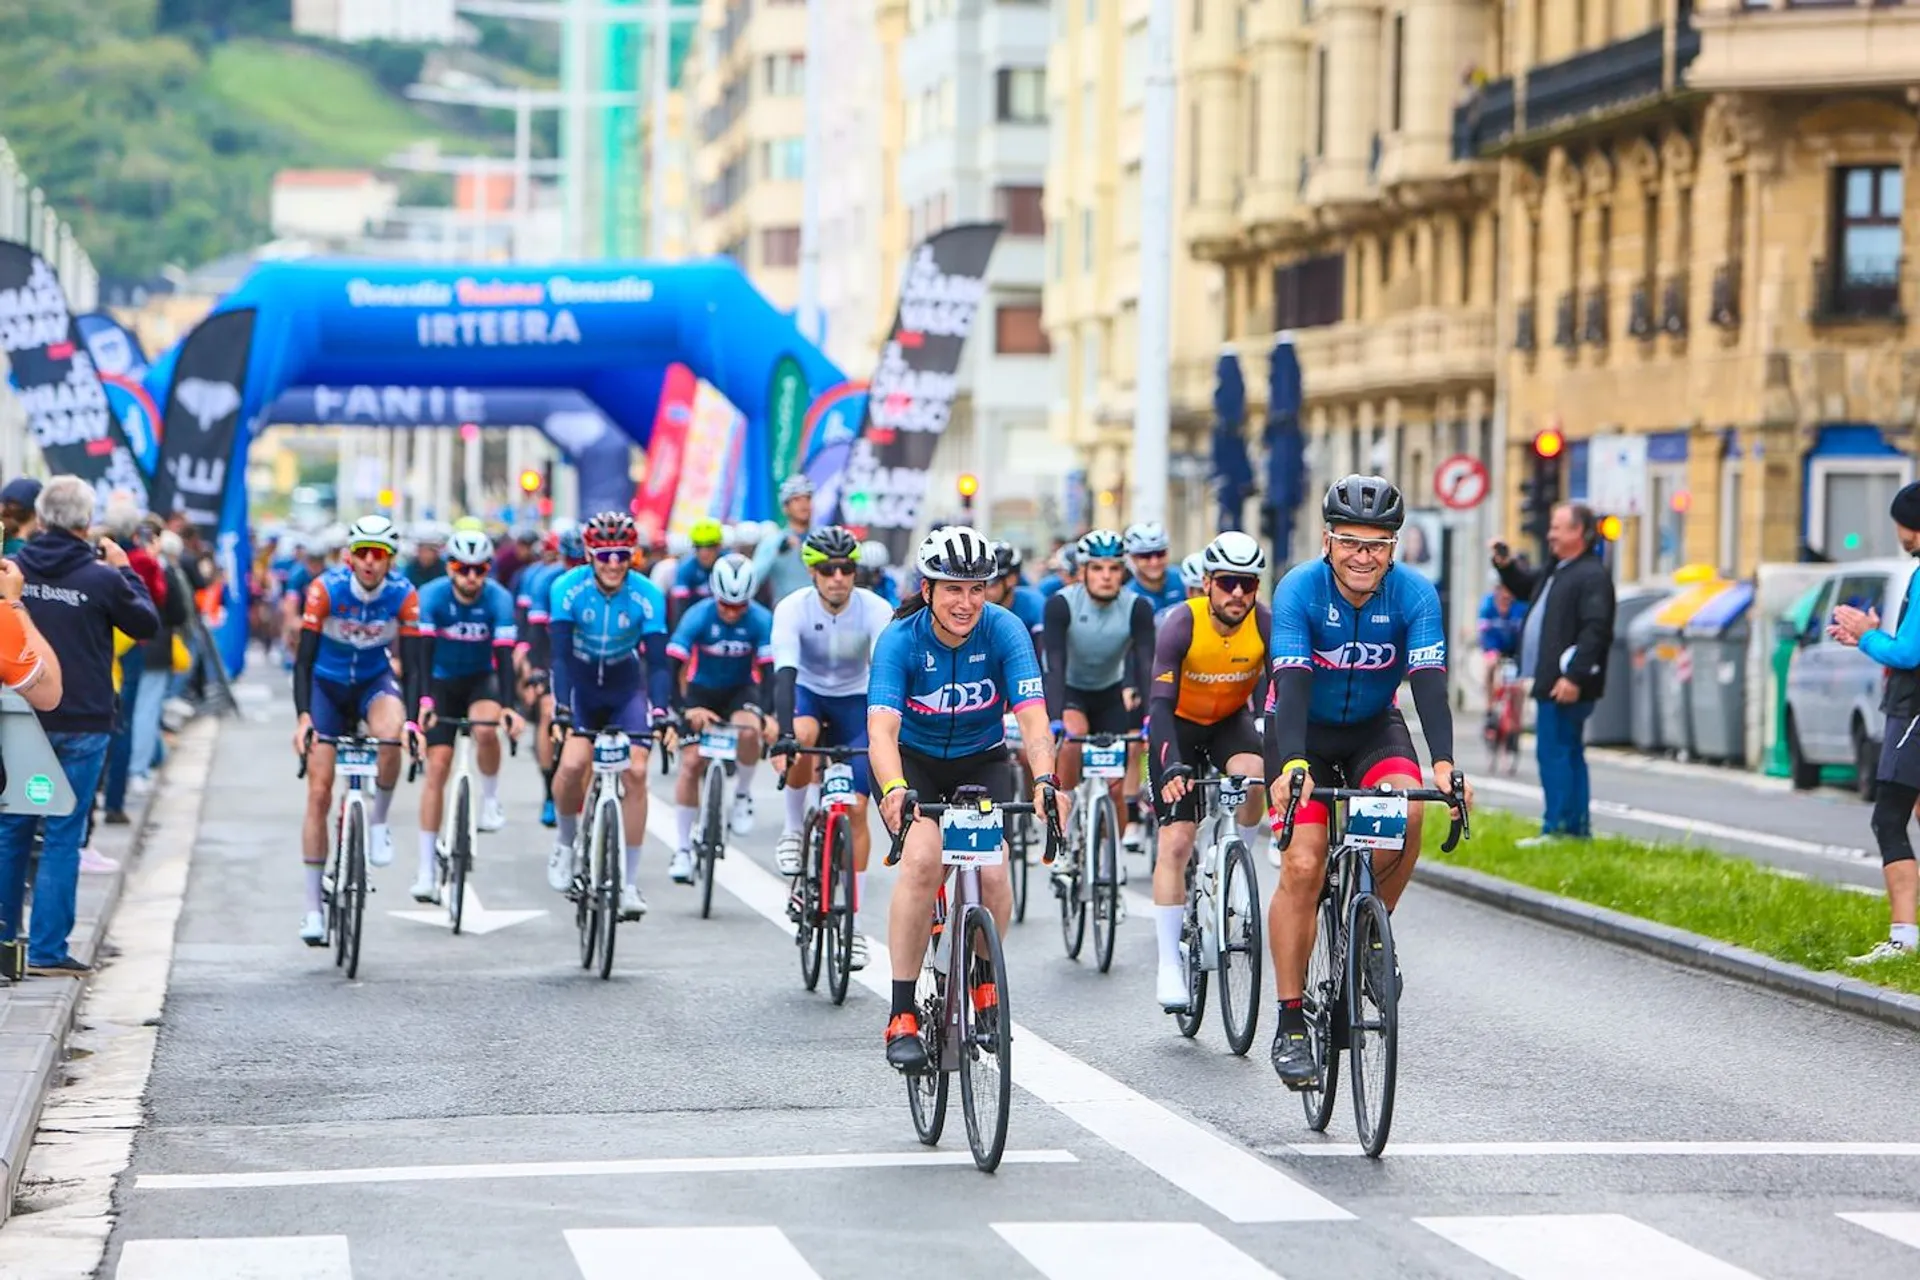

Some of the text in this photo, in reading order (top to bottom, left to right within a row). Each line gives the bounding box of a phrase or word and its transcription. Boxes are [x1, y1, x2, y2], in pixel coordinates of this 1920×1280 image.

[418, 310, 580, 347] IRTEERA
[1220, 793, 1246, 805] 983
[1372, 820, 1382, 834] 1
[967, 832, 978, 847] 1
